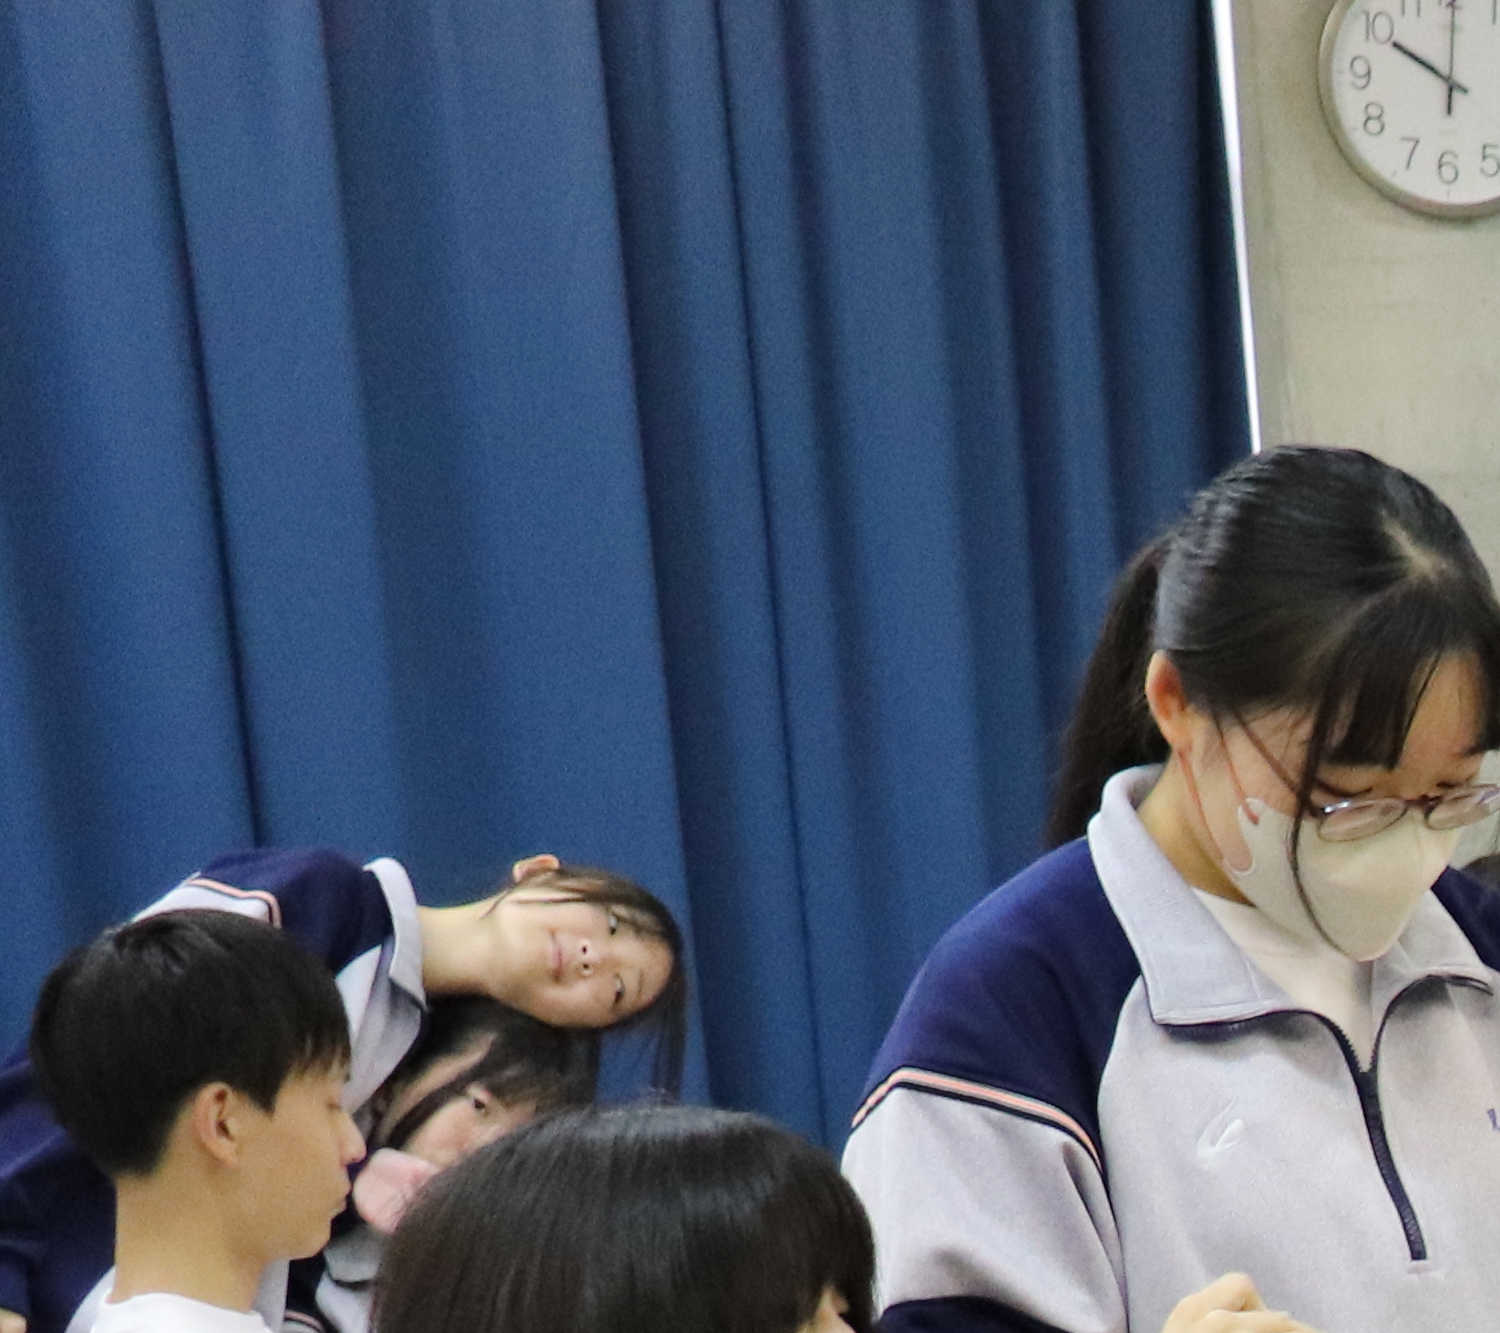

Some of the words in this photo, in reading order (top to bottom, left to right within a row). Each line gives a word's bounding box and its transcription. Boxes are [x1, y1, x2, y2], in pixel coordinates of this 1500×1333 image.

[1363, 10, 1394, 44] 10
[1350, 56, 1371, 89] 9
[1363, 102, 1385, 136] 8
[1401, 137, 1420, 170] 7
[1437, 151, 1459, 185] 6
